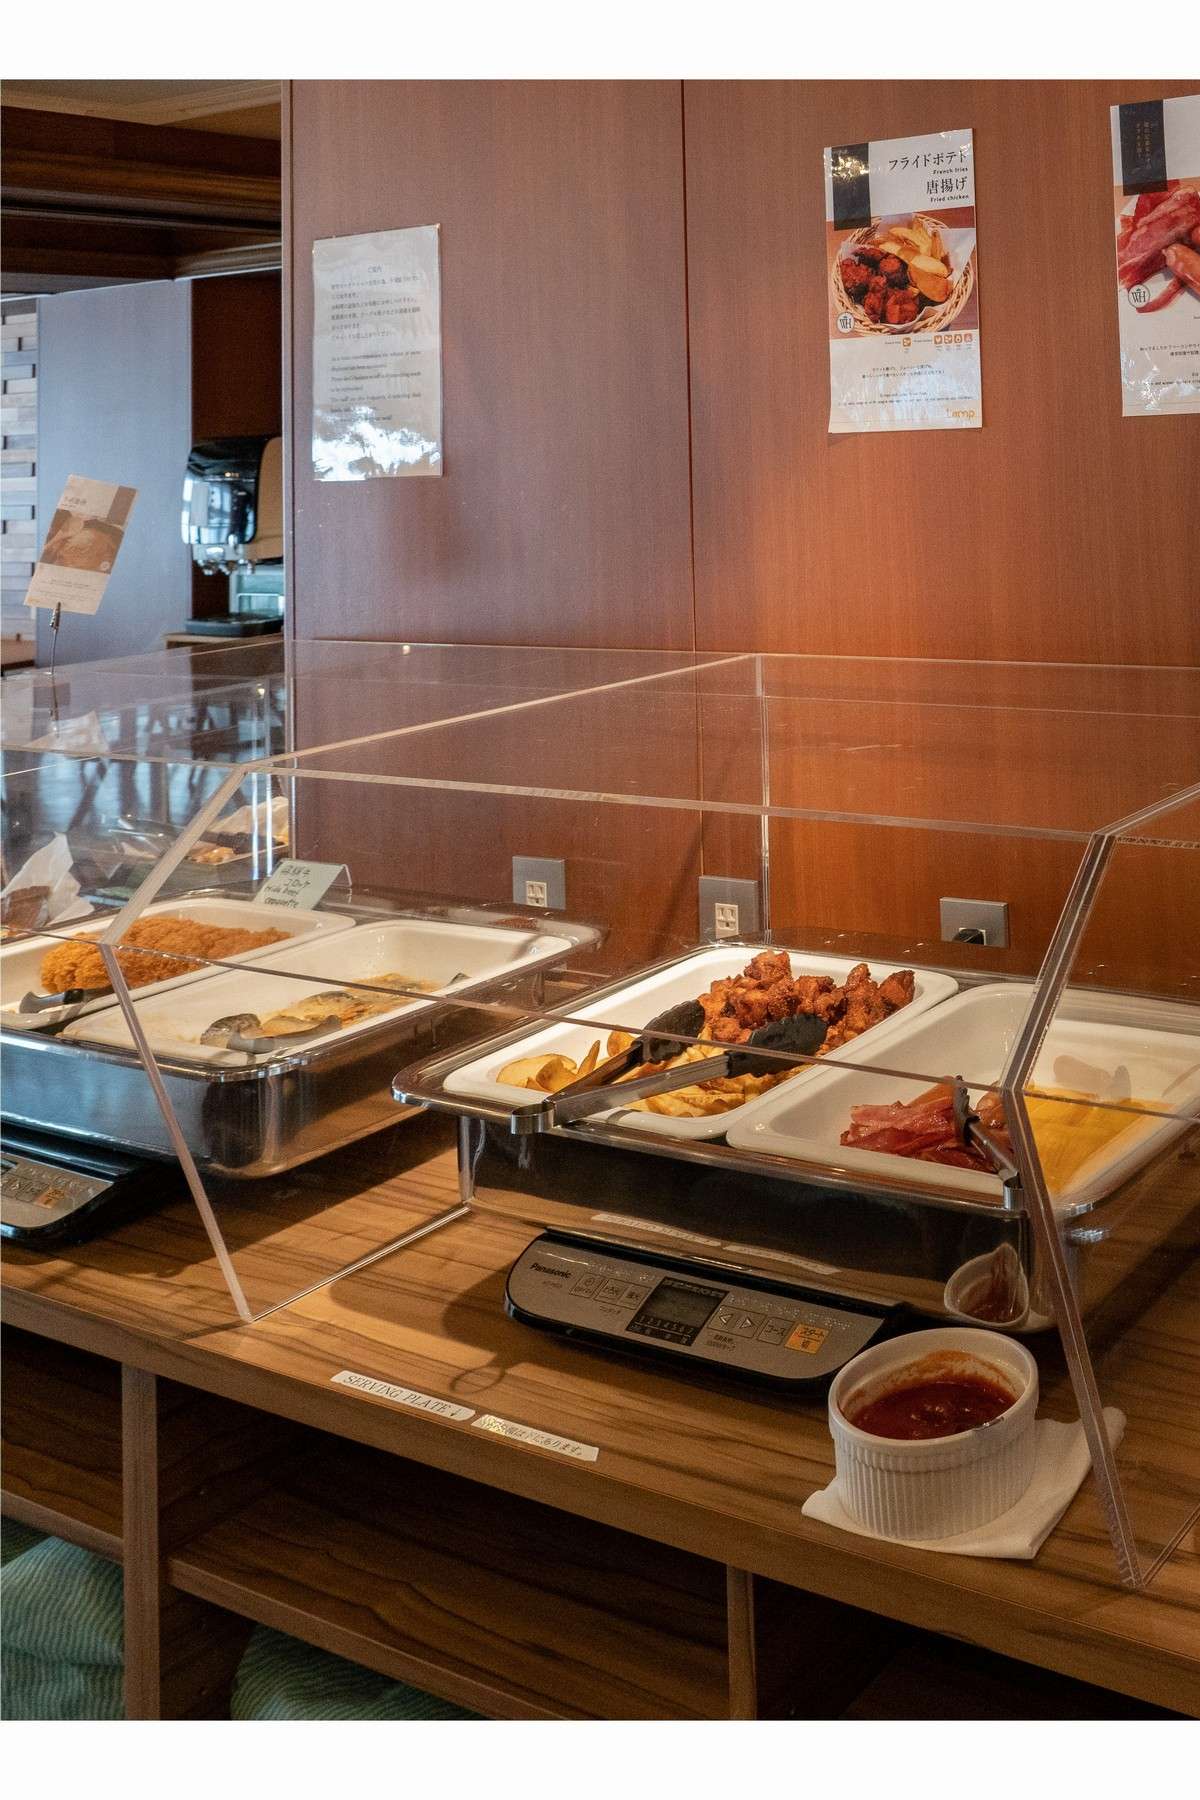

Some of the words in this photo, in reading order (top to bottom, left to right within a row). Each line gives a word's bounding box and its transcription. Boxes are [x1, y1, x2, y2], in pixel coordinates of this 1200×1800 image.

[888, 149, 967, 171] フライドポテト
[926, 176, 967, 194] 唐揚げ
[530, 1262, 572, 1279] Panasonic
[343, 1375, 402, 1399] SERVING
[403, 1393, 452, 1413] PLATE
